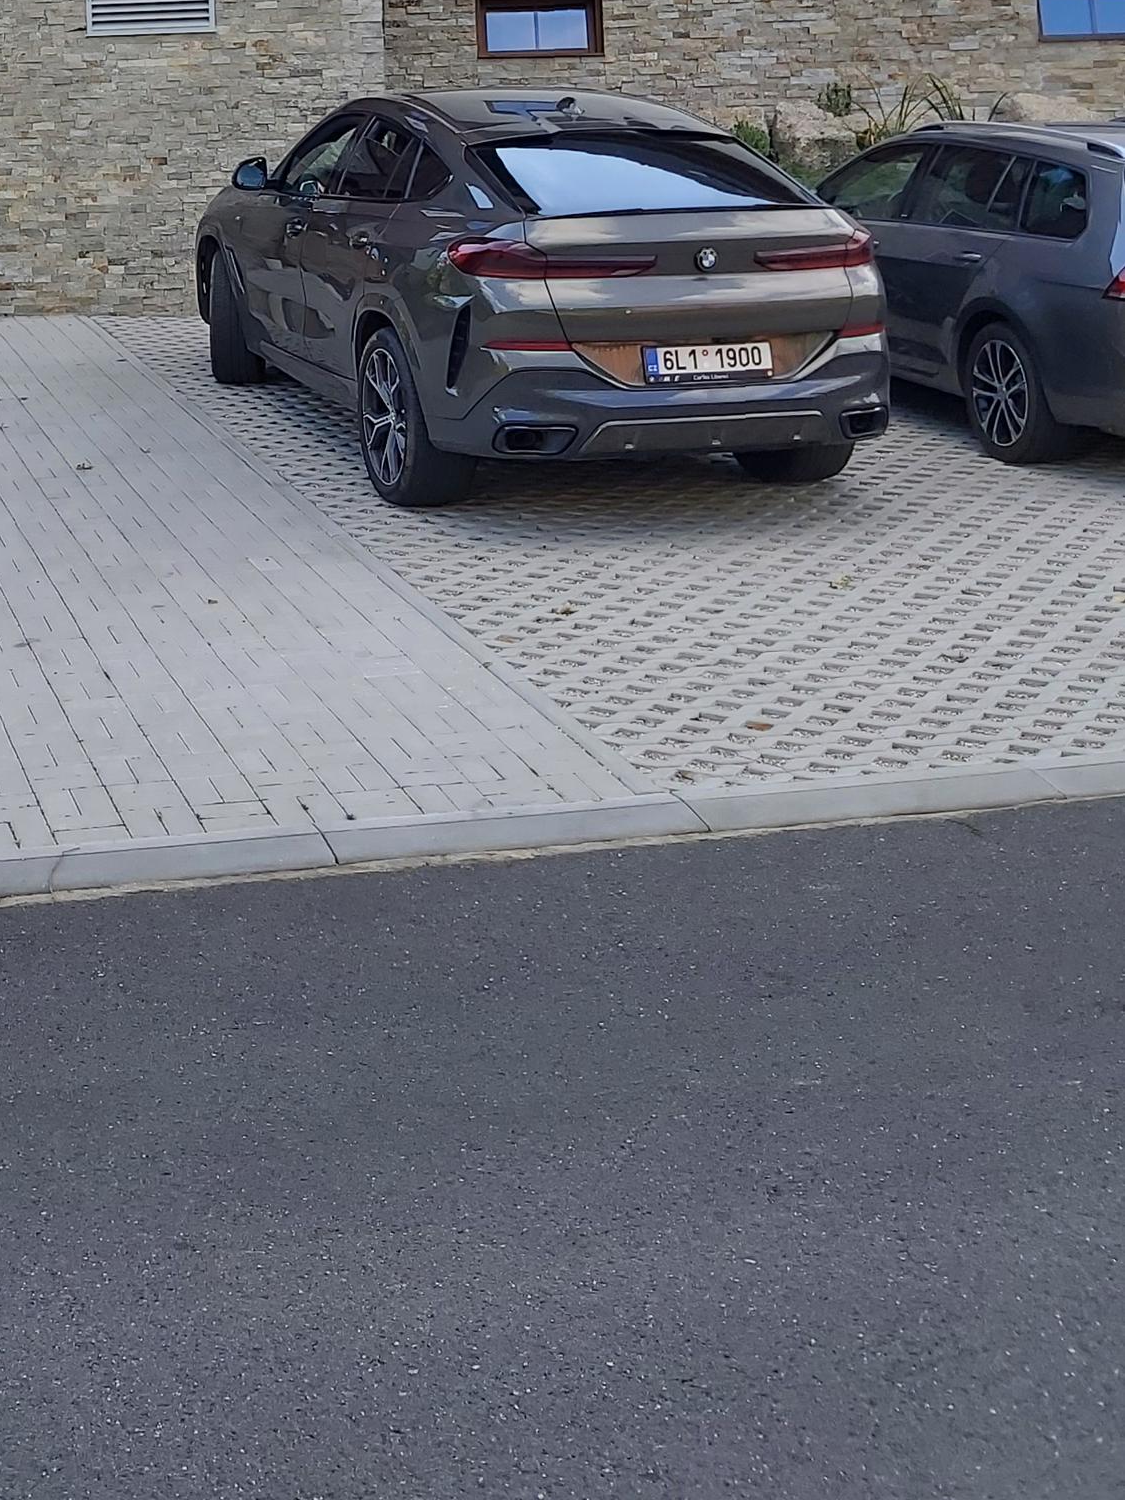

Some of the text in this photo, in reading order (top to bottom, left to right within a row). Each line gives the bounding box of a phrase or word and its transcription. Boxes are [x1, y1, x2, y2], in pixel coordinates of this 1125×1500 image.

[663, 346, 762, 370] 6L1 1900
[647, 364, 658, 372] CZ
